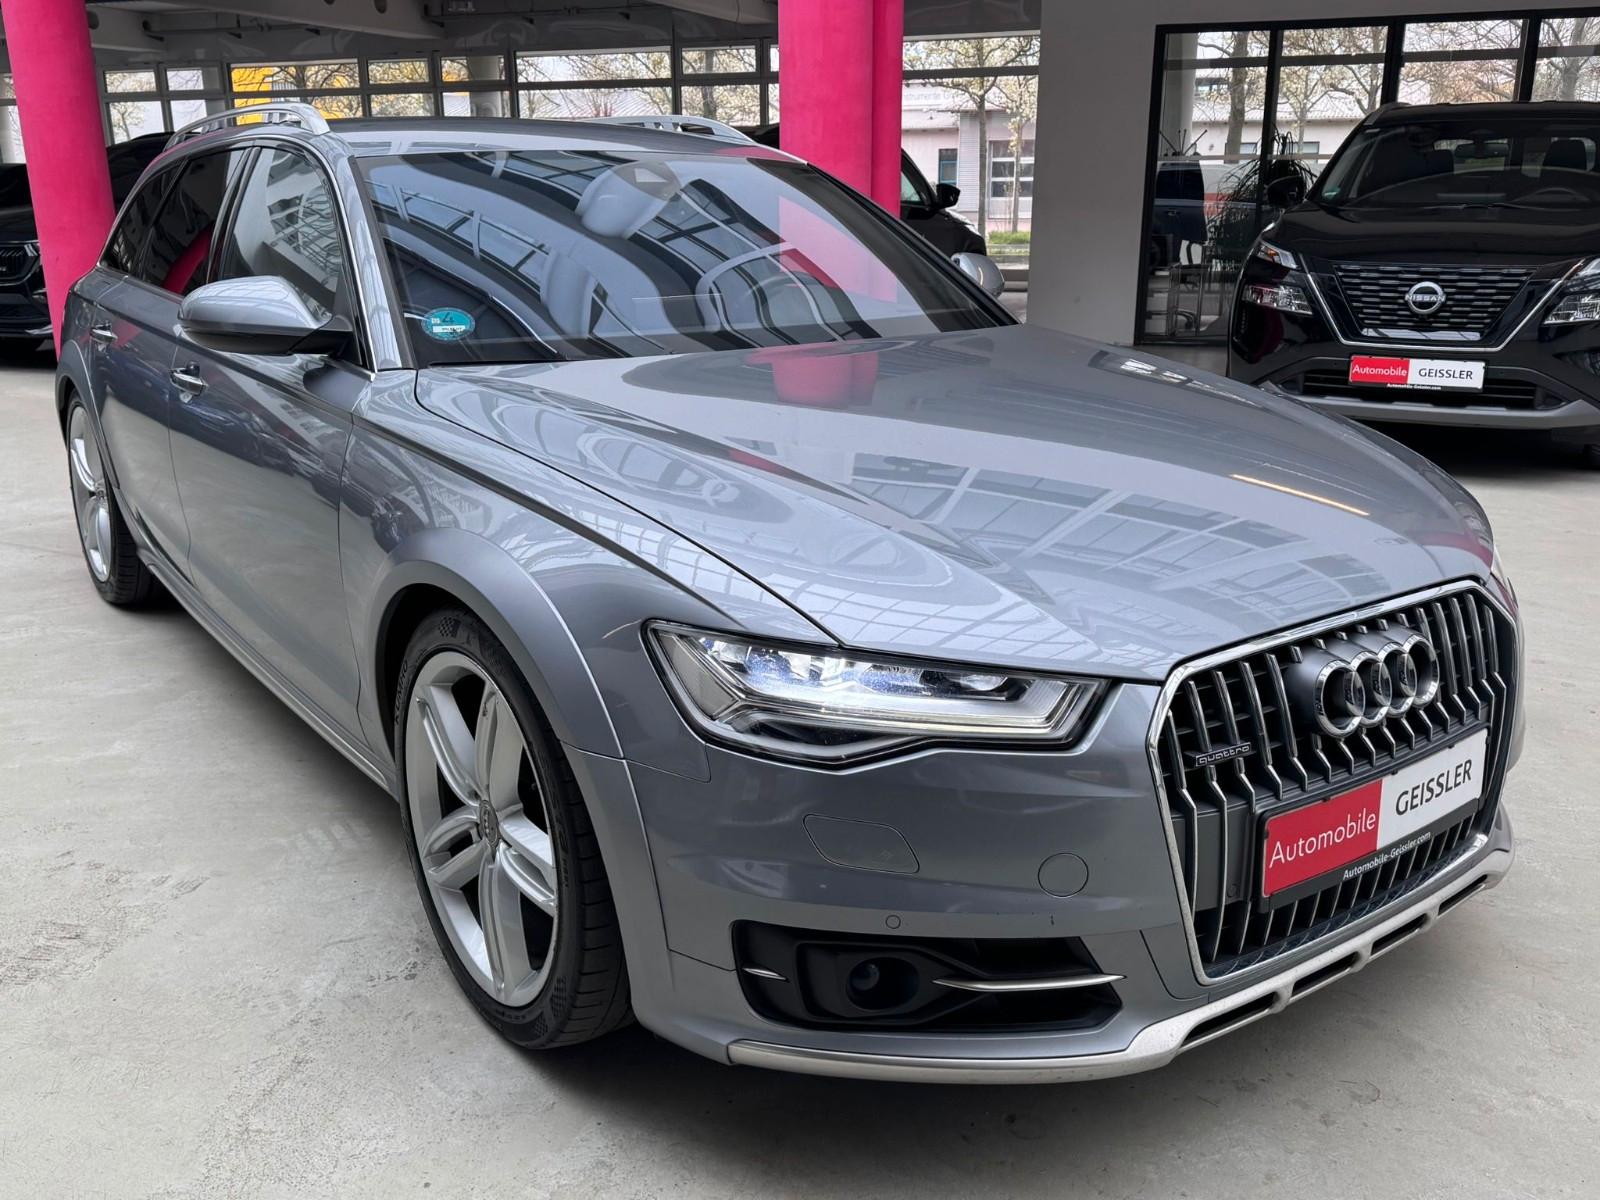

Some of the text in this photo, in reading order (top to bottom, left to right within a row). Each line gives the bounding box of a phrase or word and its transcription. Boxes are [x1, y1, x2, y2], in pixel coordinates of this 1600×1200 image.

[1404, 293, 1447, 302] NISSAN
[1352, 364, 1473, 380] Automobile GEISSLER
[1199, 746, 1250, 765] quattro
[1270, 759, 1473, 868] Automobile GEISSLER
[1342, 831, 1432, 880] Automobile-Geissler.com
